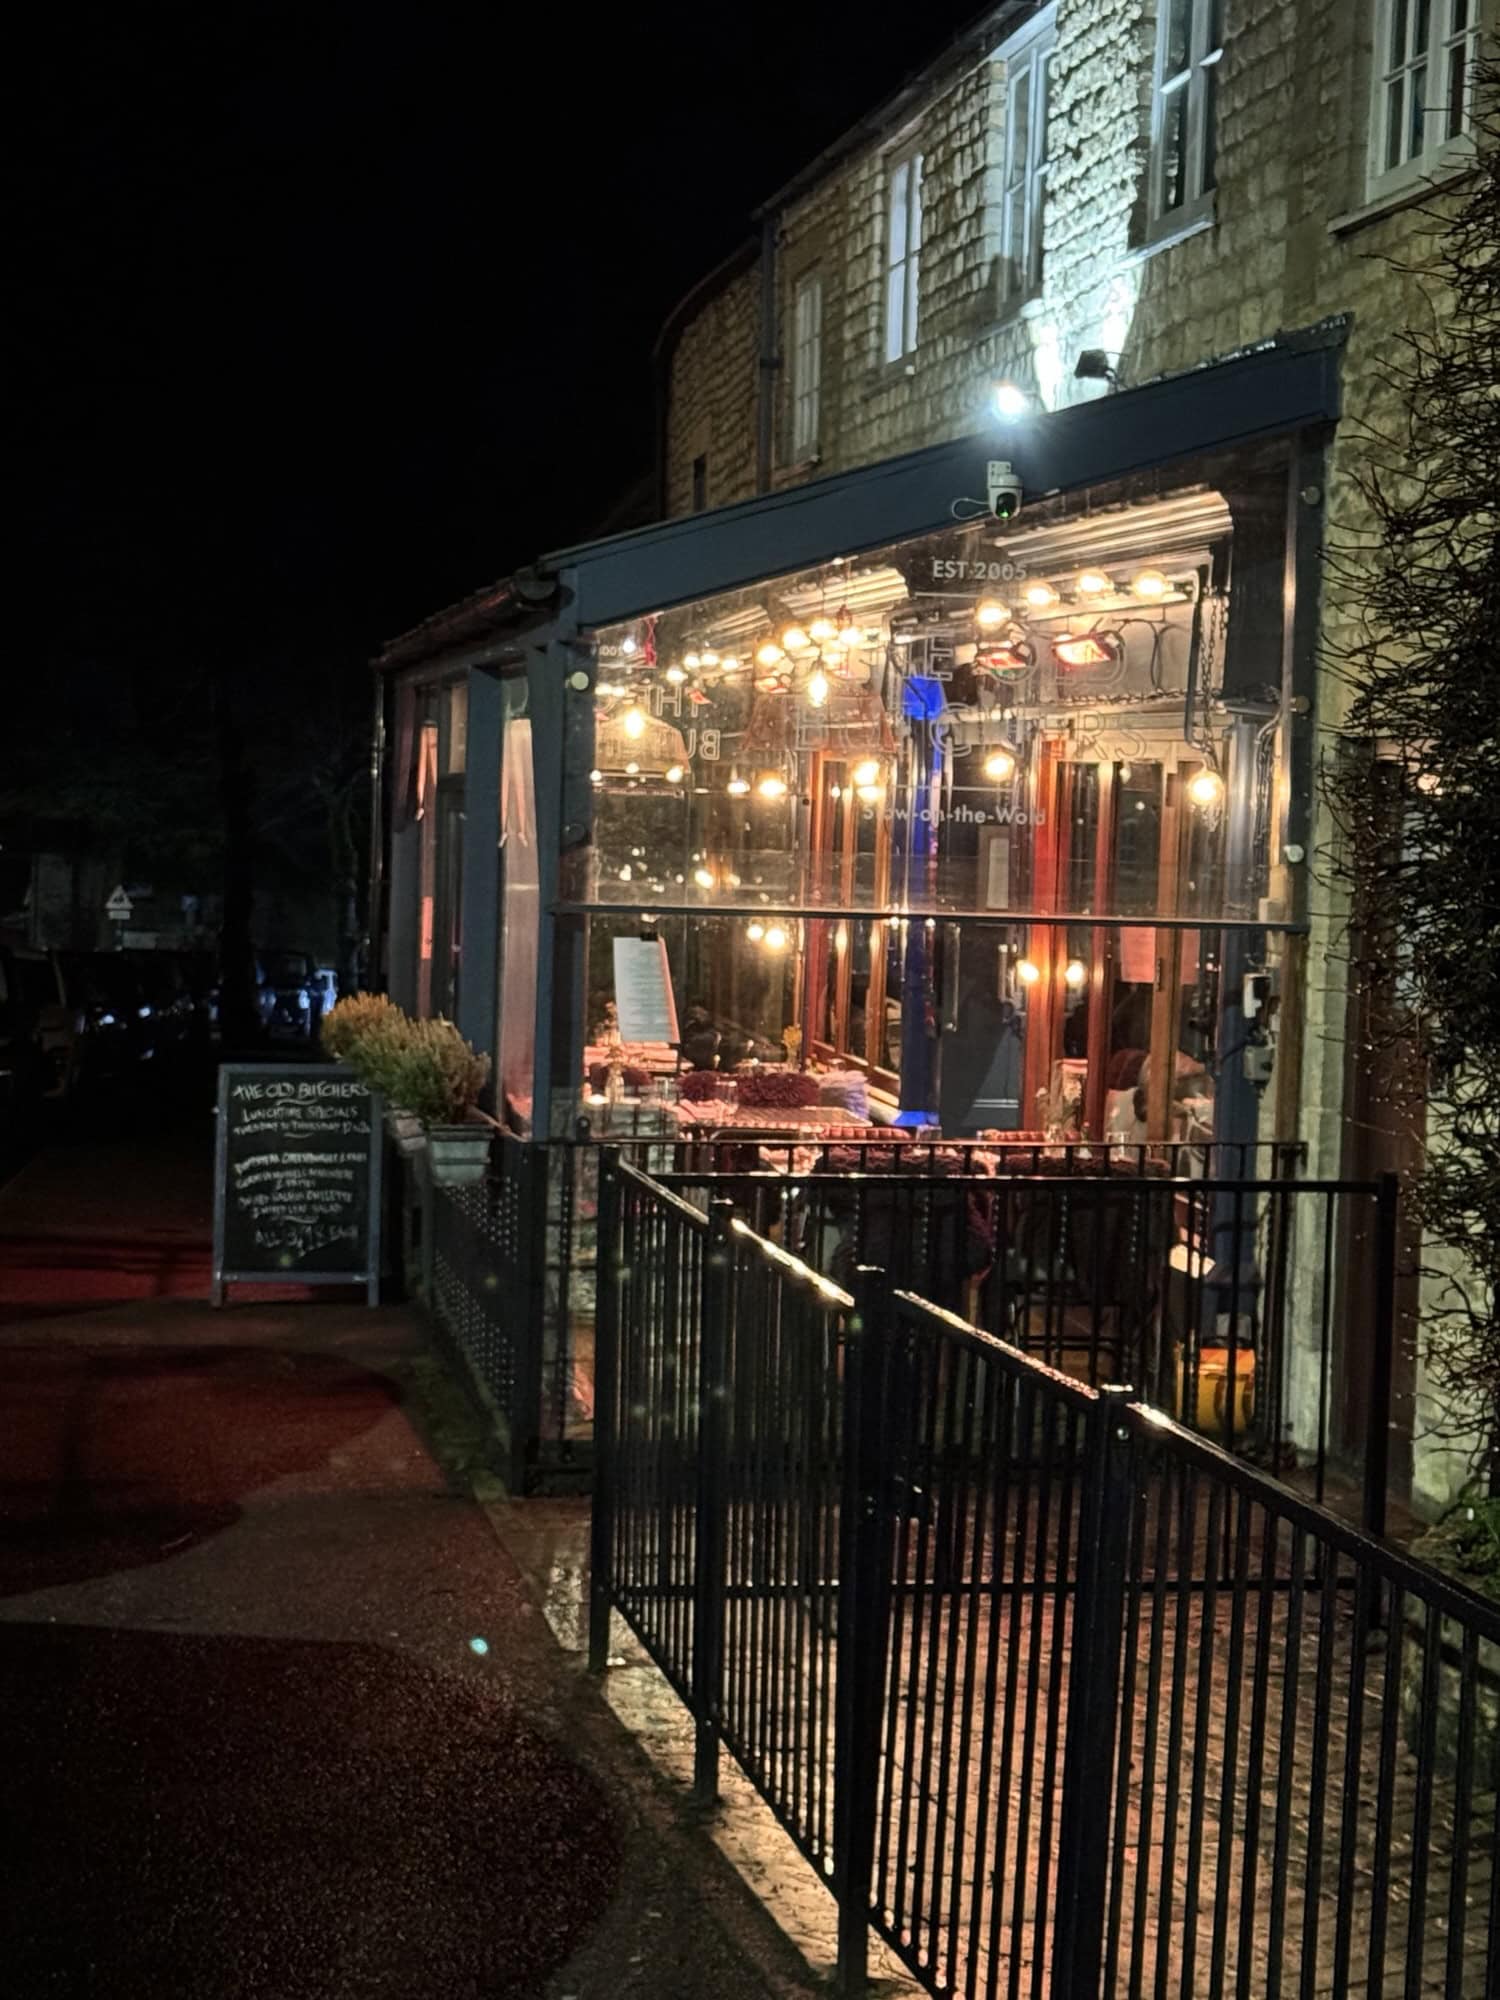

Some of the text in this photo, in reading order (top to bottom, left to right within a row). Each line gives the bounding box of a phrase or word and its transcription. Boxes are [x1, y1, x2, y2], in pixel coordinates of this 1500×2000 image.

[863, 804, 1046, 826] Sow-on-the-Wold
[232, 1080, 370, 1101] THE OLD BUTCHERS
